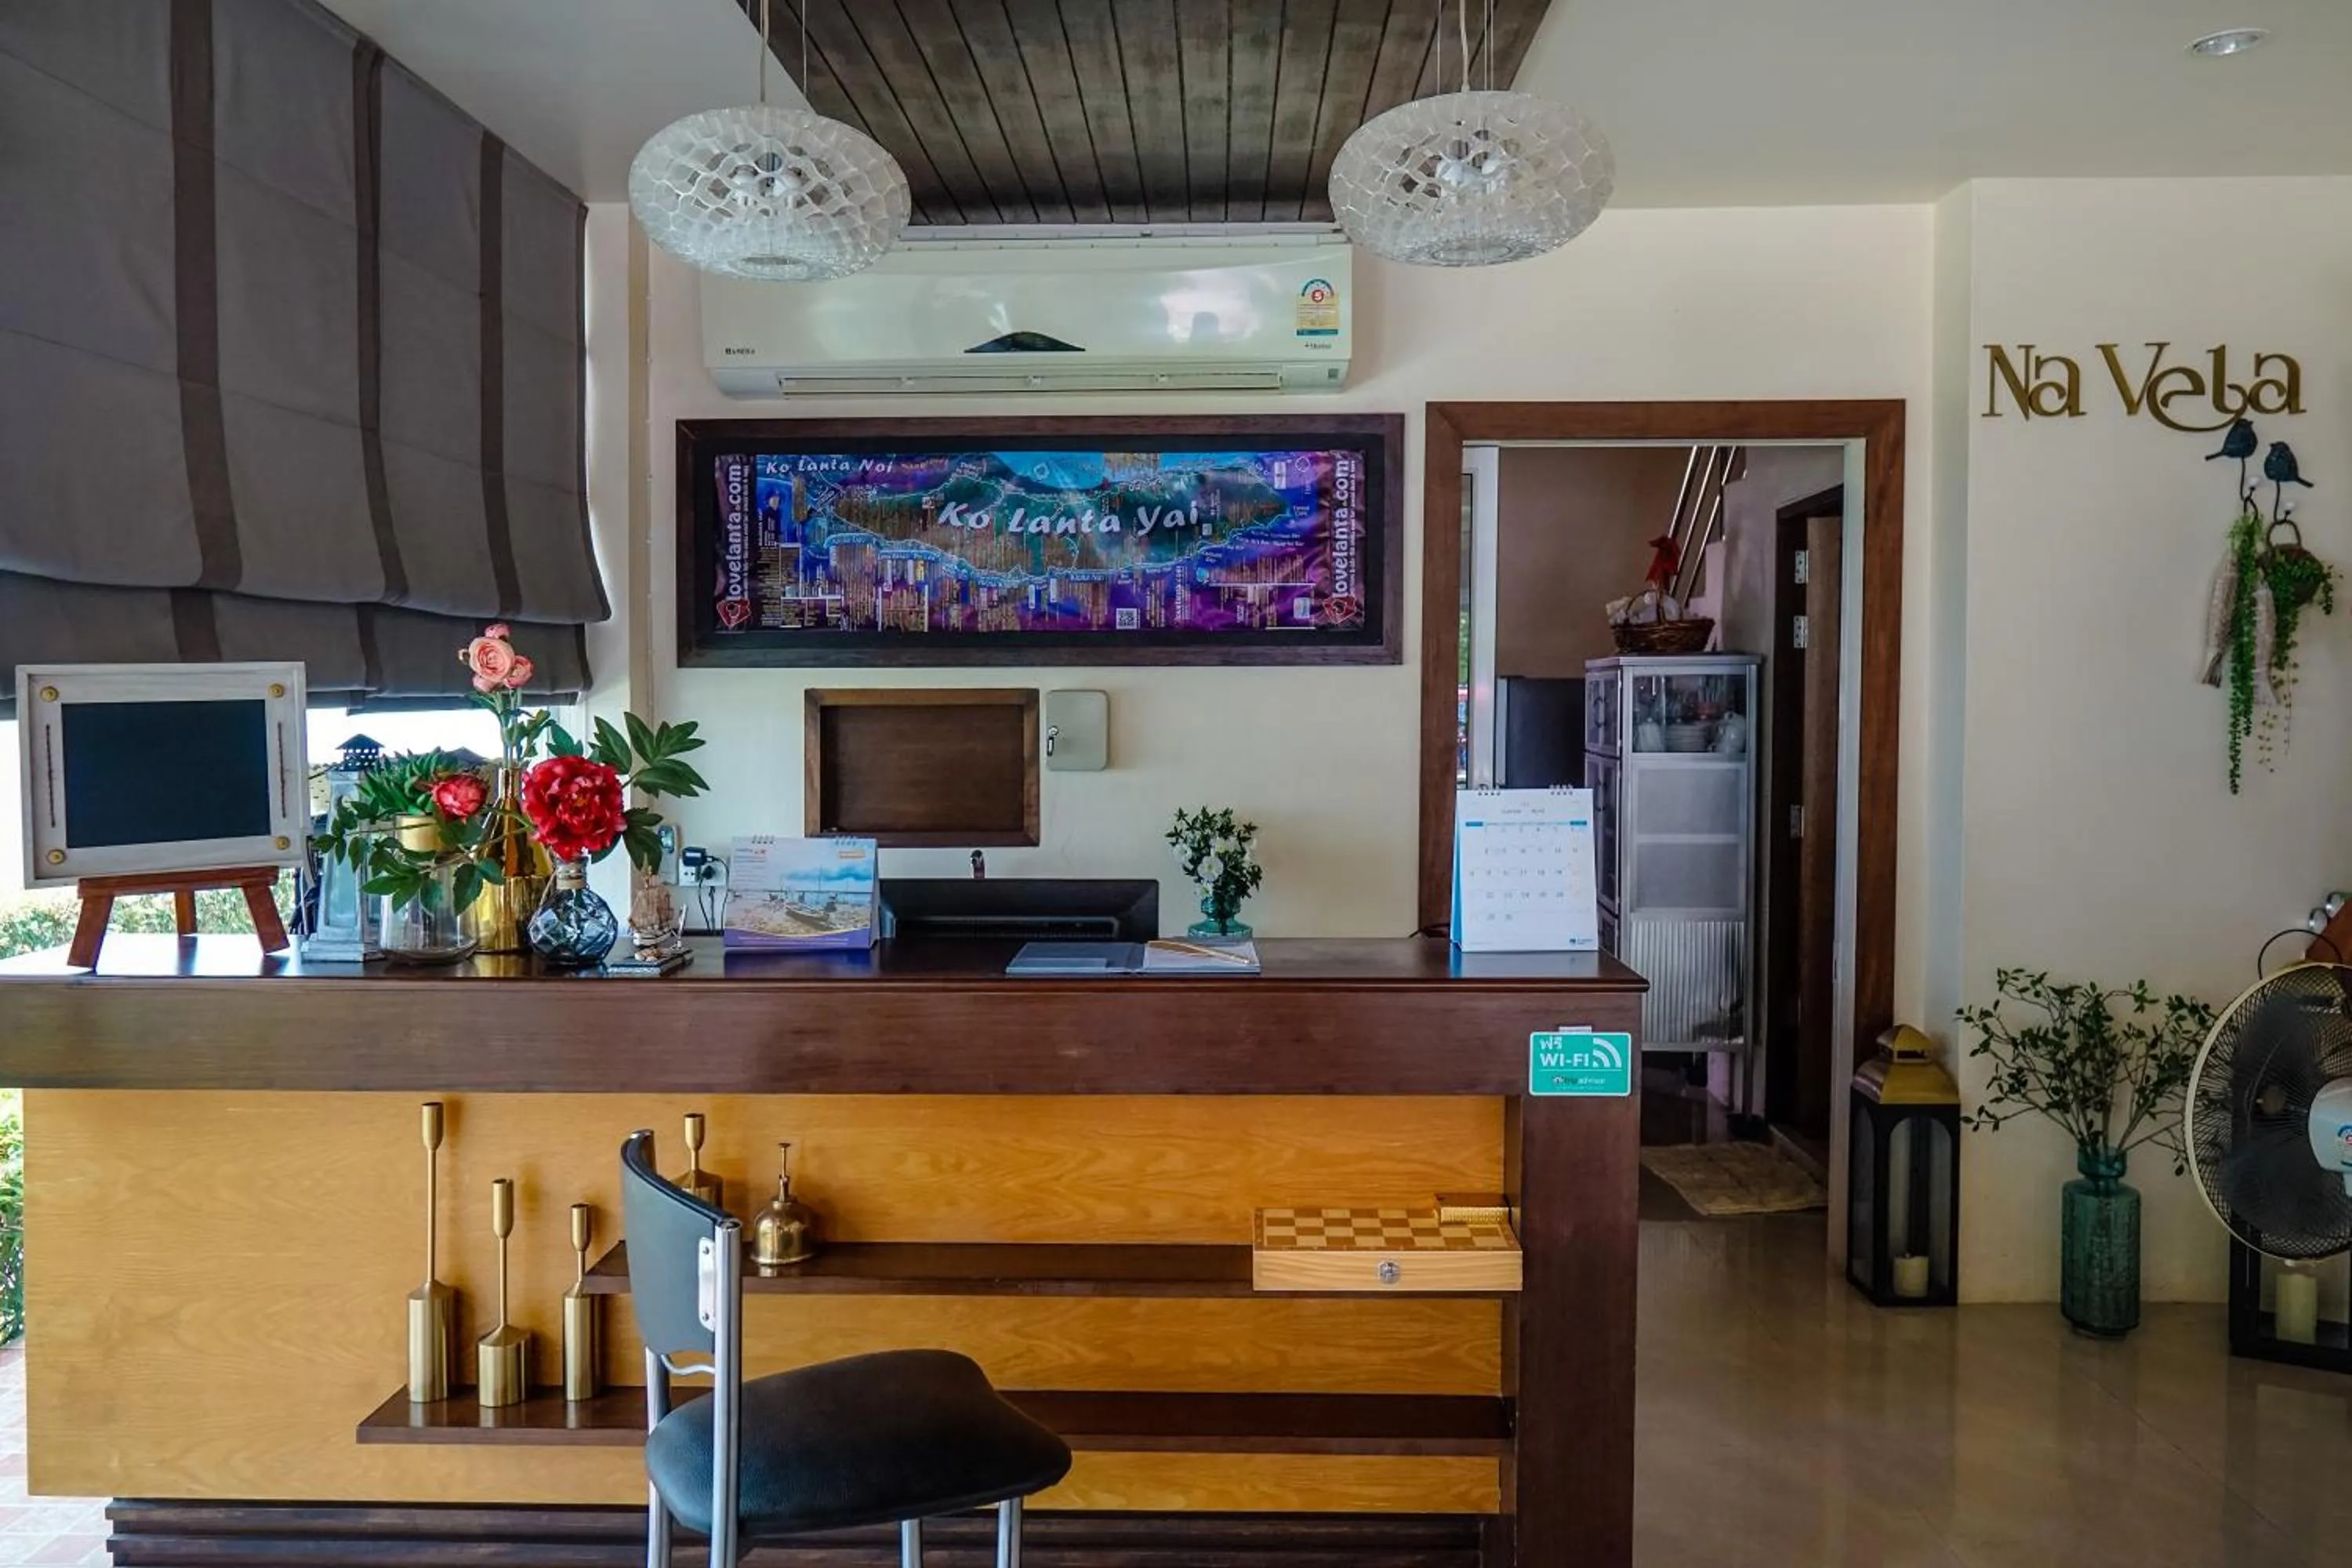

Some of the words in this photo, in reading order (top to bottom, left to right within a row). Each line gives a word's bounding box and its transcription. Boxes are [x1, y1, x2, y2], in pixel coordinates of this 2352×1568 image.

[1981, 344, 2087, 421] Na
[766, 462, 789, 474] Ko
[798, 458, 850, 471] Lanta
[858, 459, 893, 473] Noi
[726, 464, 742, 601] lovelanta.com
[937, 501, 990, 529] Ko
[1008, 507, 1121, 534] Lanta
[1332, 459, 1349, 598] lovelanta.com
[1539, 1053, 1590, 1067] WI-FI
